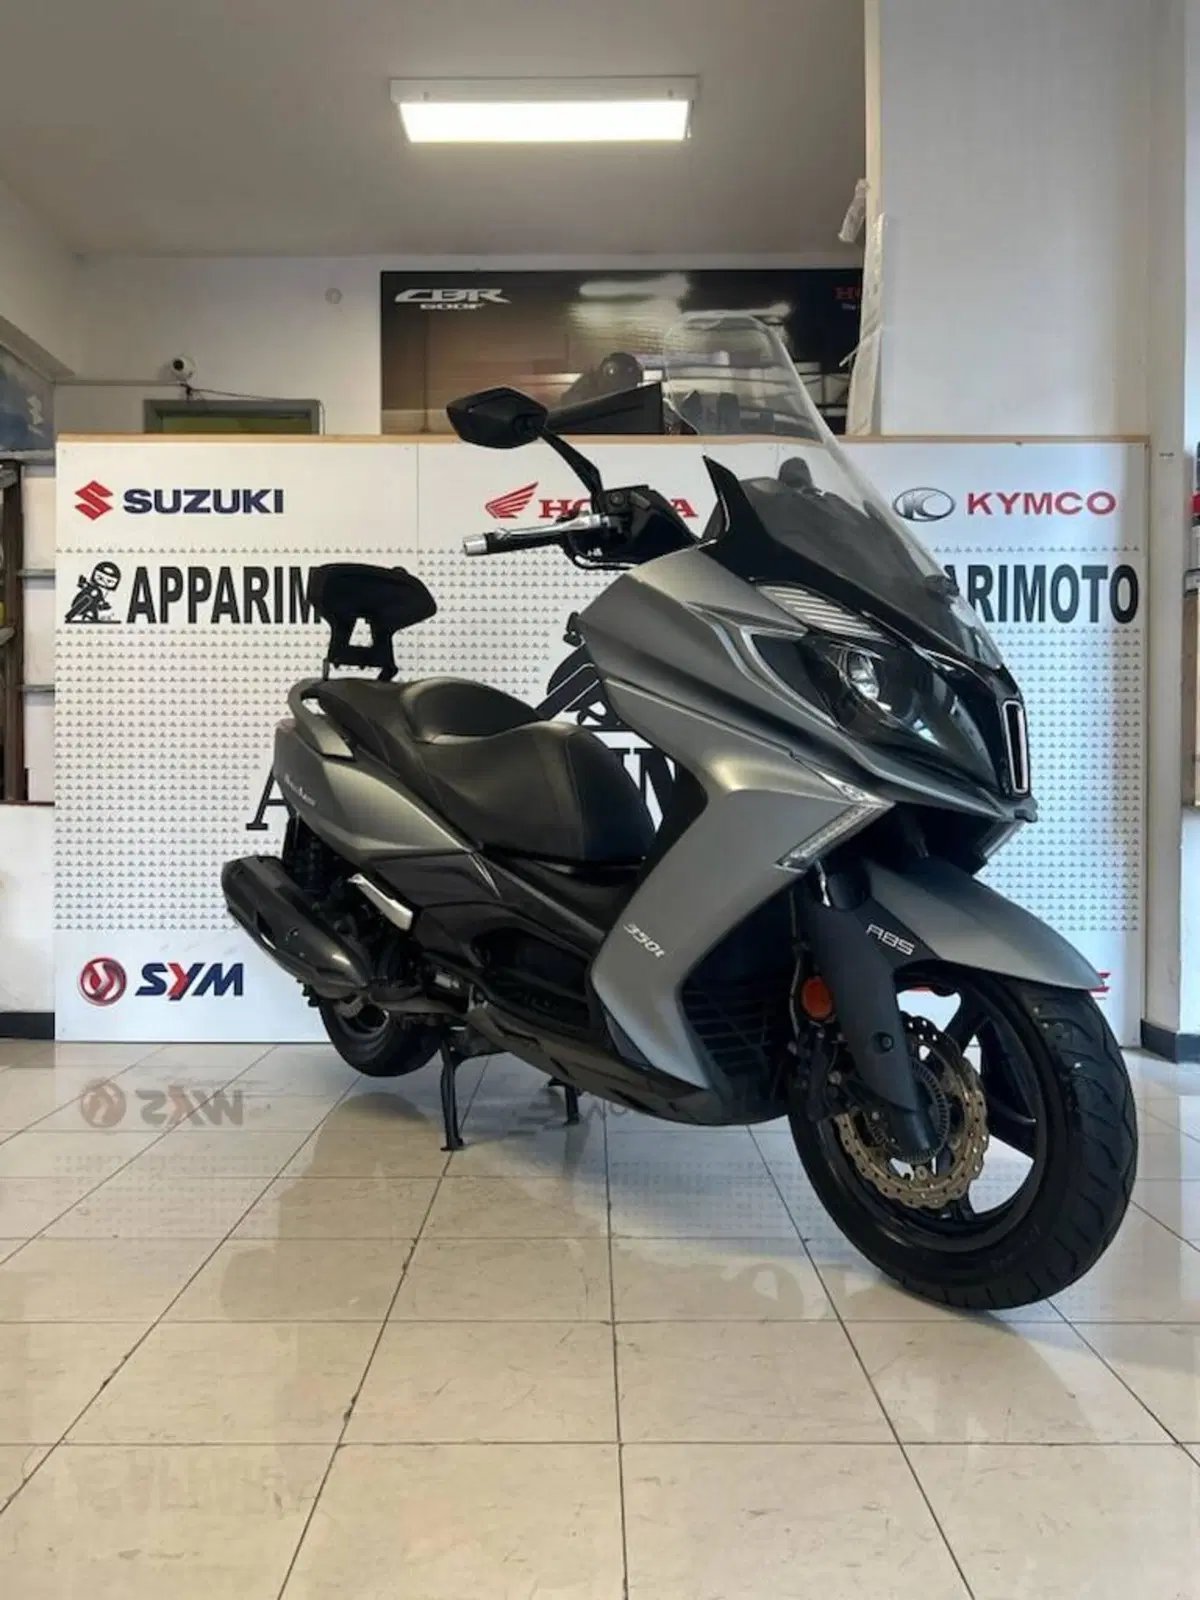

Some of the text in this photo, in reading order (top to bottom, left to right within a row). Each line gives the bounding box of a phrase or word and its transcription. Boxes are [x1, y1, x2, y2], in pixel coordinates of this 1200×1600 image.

[395, 288, 511, 304] CBR
[123, 489, 284, 514] SUZUKI
[967, 492, 1116, 515] KYMCO
[127, 566, 324, 624] APPARIM
[865, 923, 915, 956] ABS
[135, 963, 244, 1001] SYM
